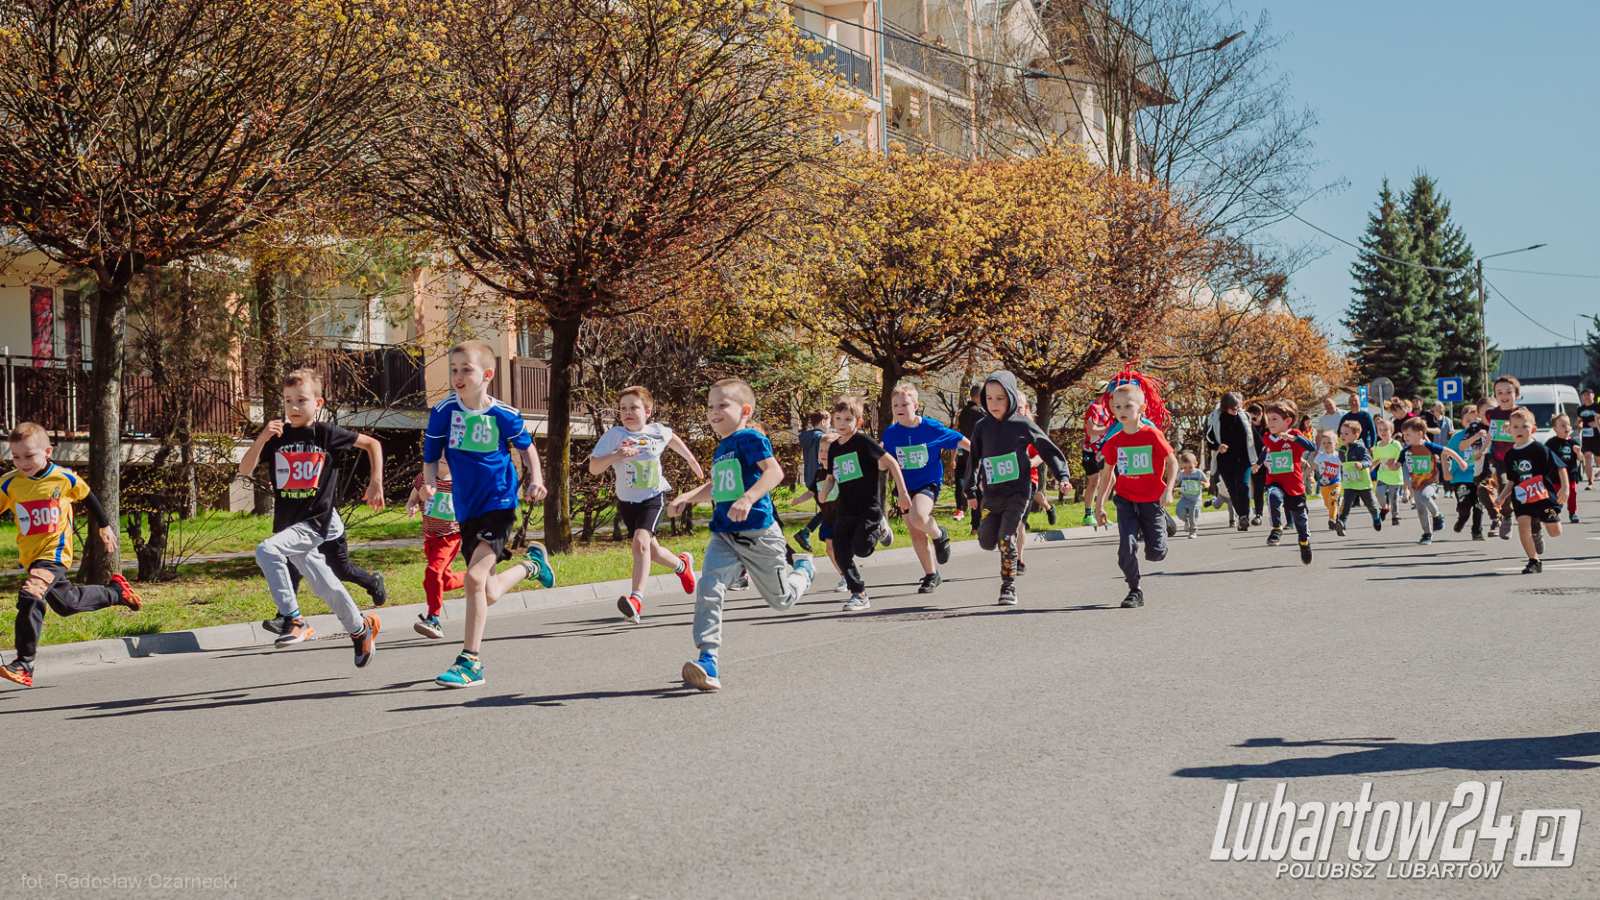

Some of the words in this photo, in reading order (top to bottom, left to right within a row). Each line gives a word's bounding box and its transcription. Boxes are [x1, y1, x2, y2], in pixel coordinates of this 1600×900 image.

[1443, 381, 1458, 400] P
[471, 422, 492, 444] 85
[841, 459, 856, 475] 96
[997, 460, 1014, 476] 69
[1133, 452, 1149, 468] 80
[1275, 456, 1289, 468] 52
[292, 461, 322, 480] 304
[719, 469, 736, 491] 78
[32, 507, 60, 527] 309
